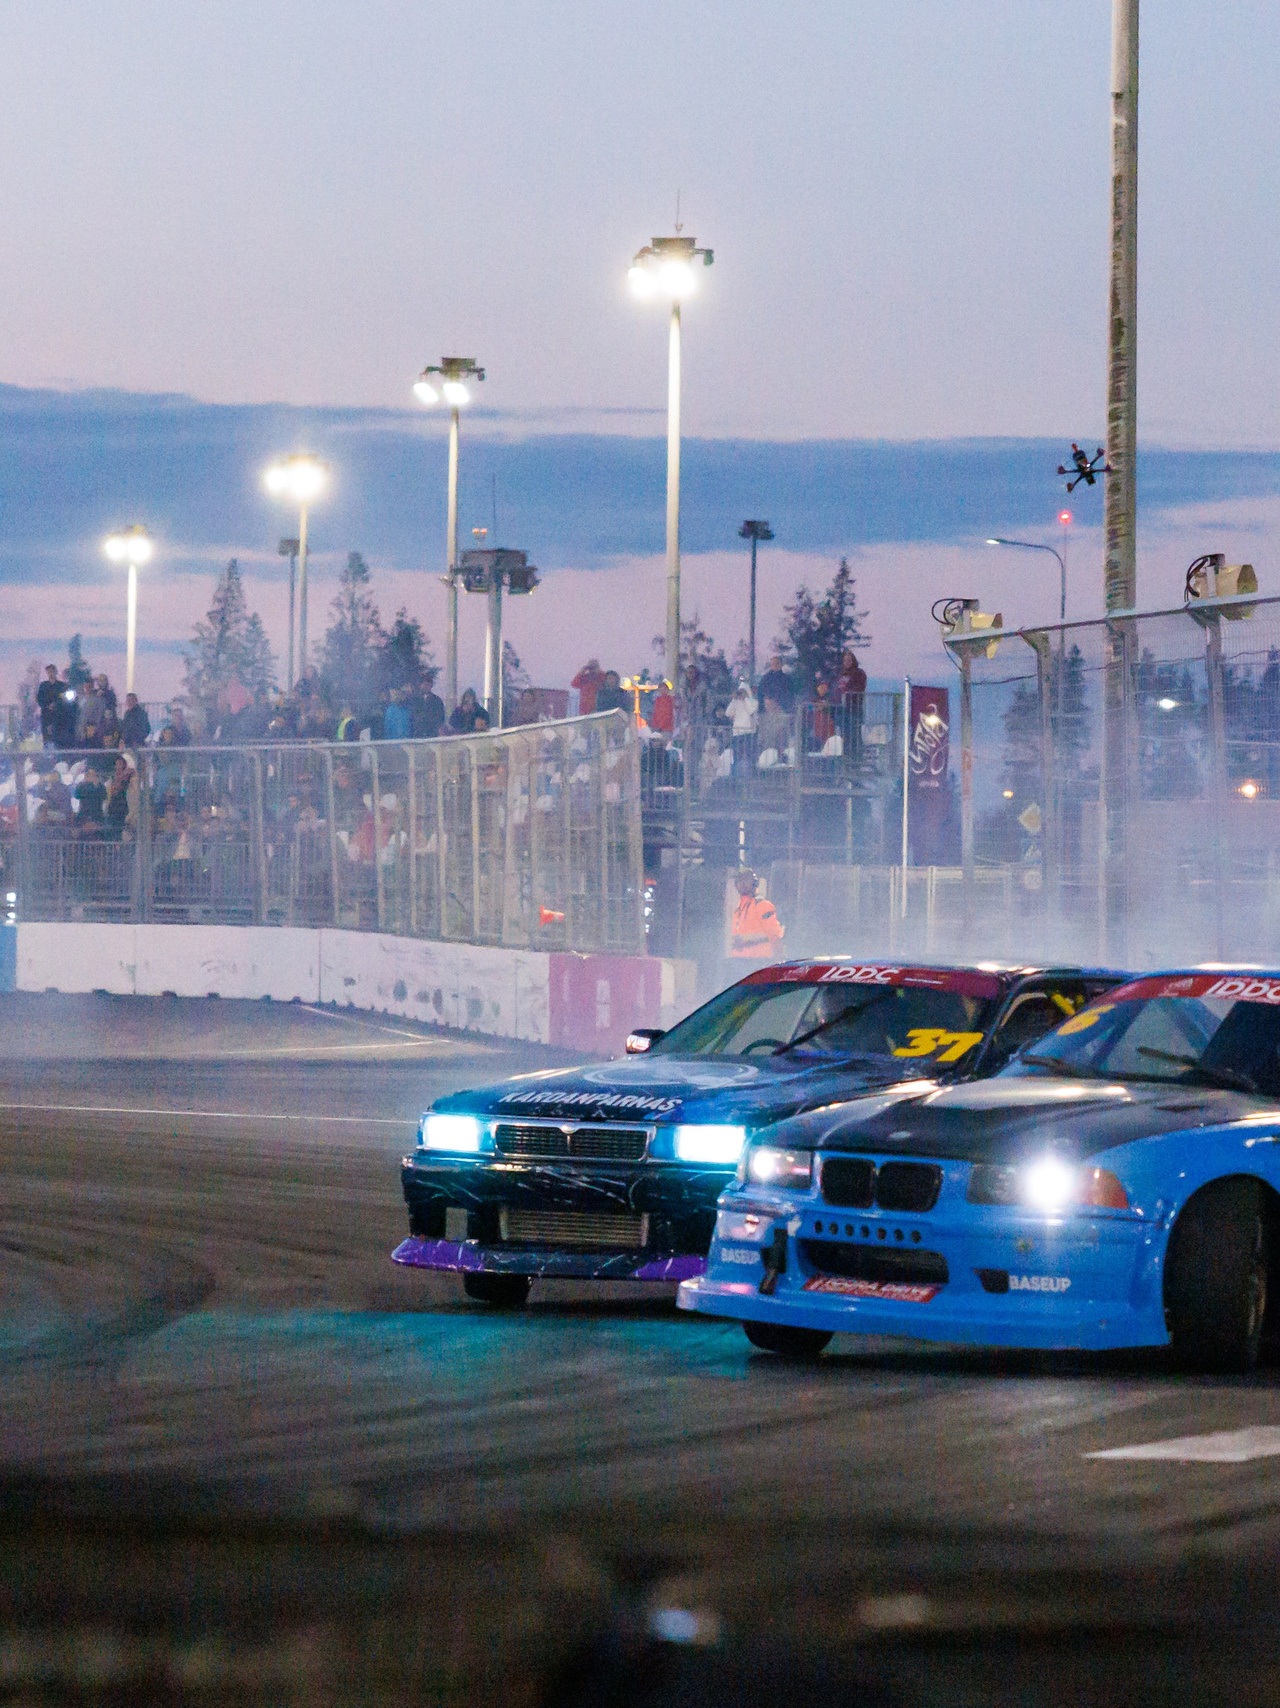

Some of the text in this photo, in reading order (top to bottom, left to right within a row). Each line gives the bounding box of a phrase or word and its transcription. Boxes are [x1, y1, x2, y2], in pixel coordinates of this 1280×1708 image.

[820, 966, 900, 982] IDDC
[893, 1028, 984, 1062] 37
[497, 1091, 683, 1111] KARDANPARNAS
[1009, 1275, 1072, 1293] BASEUP
